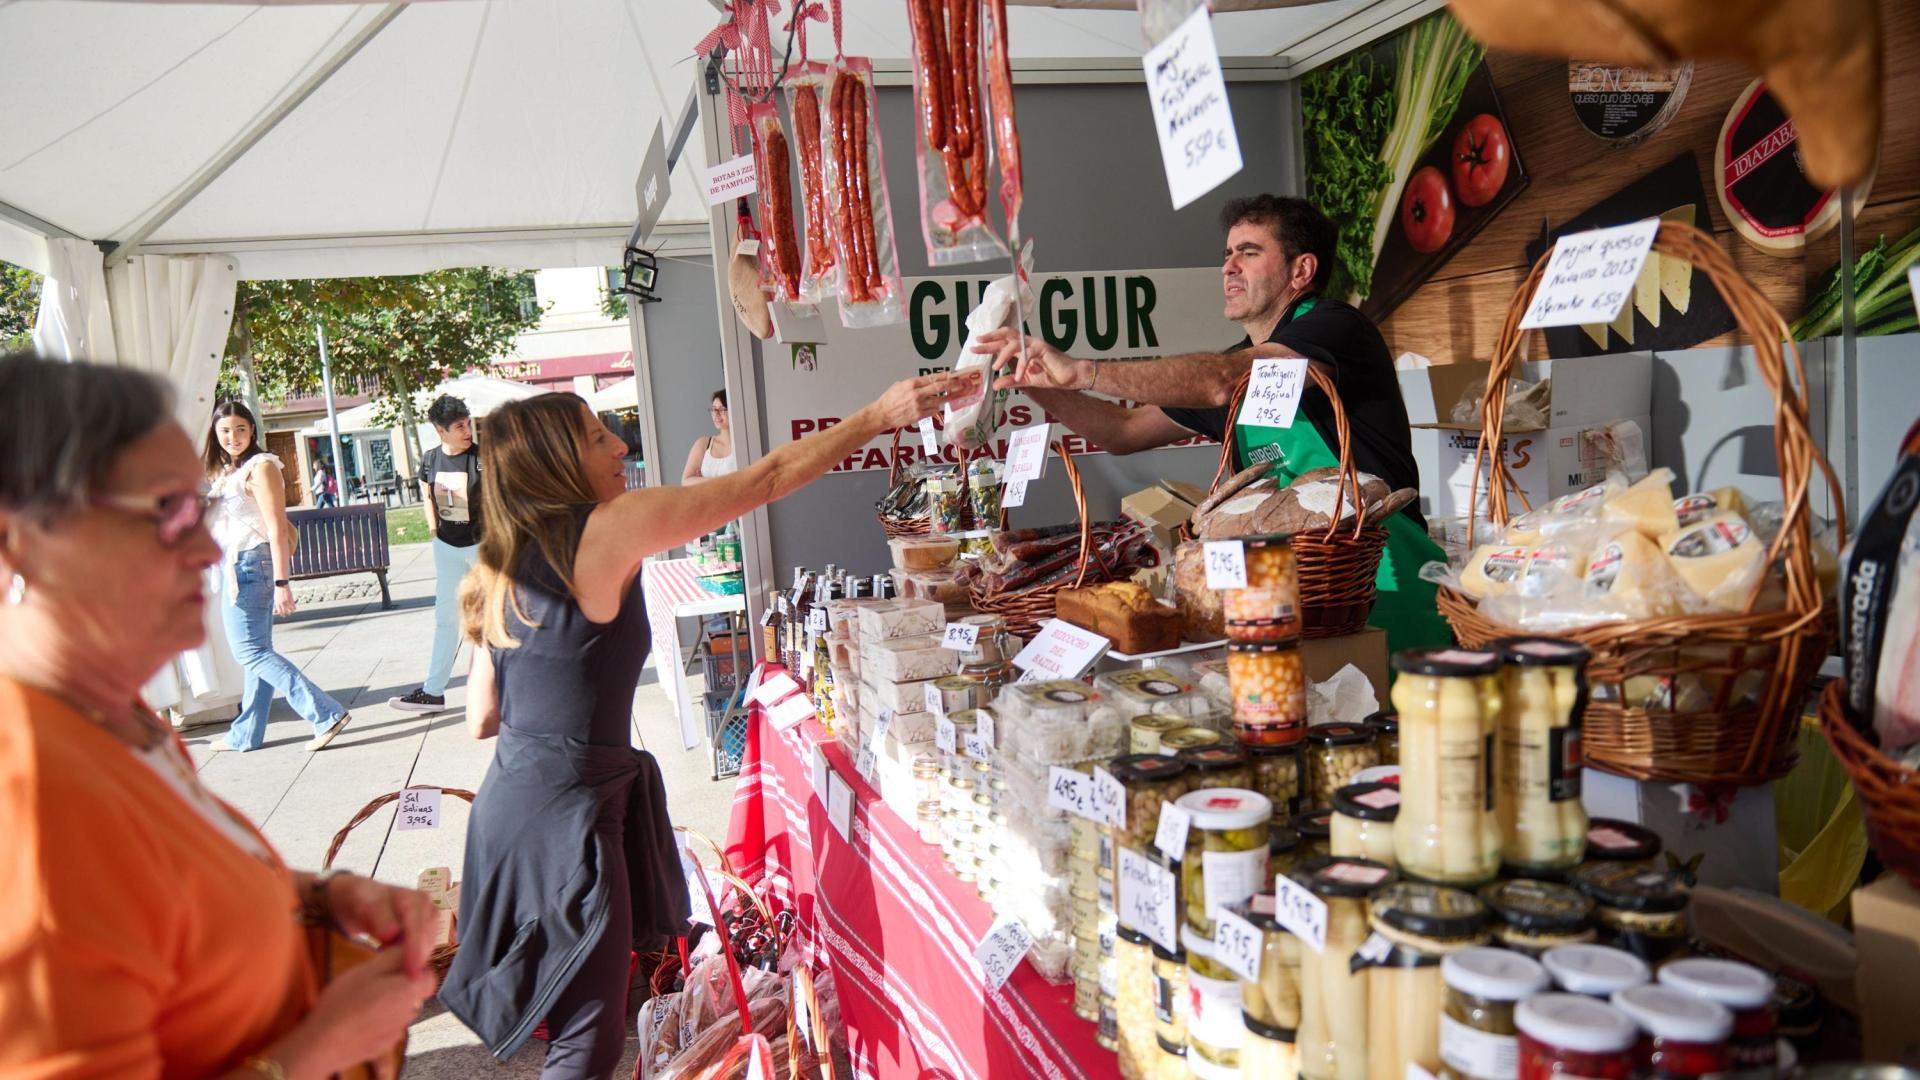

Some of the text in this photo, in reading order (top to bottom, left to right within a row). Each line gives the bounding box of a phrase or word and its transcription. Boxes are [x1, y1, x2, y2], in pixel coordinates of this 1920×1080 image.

[1574, 92, 1654, 106] queso puro de oveja
[712, 169, 735, 184] BOTAS
[710, 174, 755, 195] DE PAMPLON
[1601, 233, 1646, 259] queso
[909, 275, 1159, 360] GUGUR
[1251, 385, 1261, 399] de
[405, 792, 419, 804] Sal
